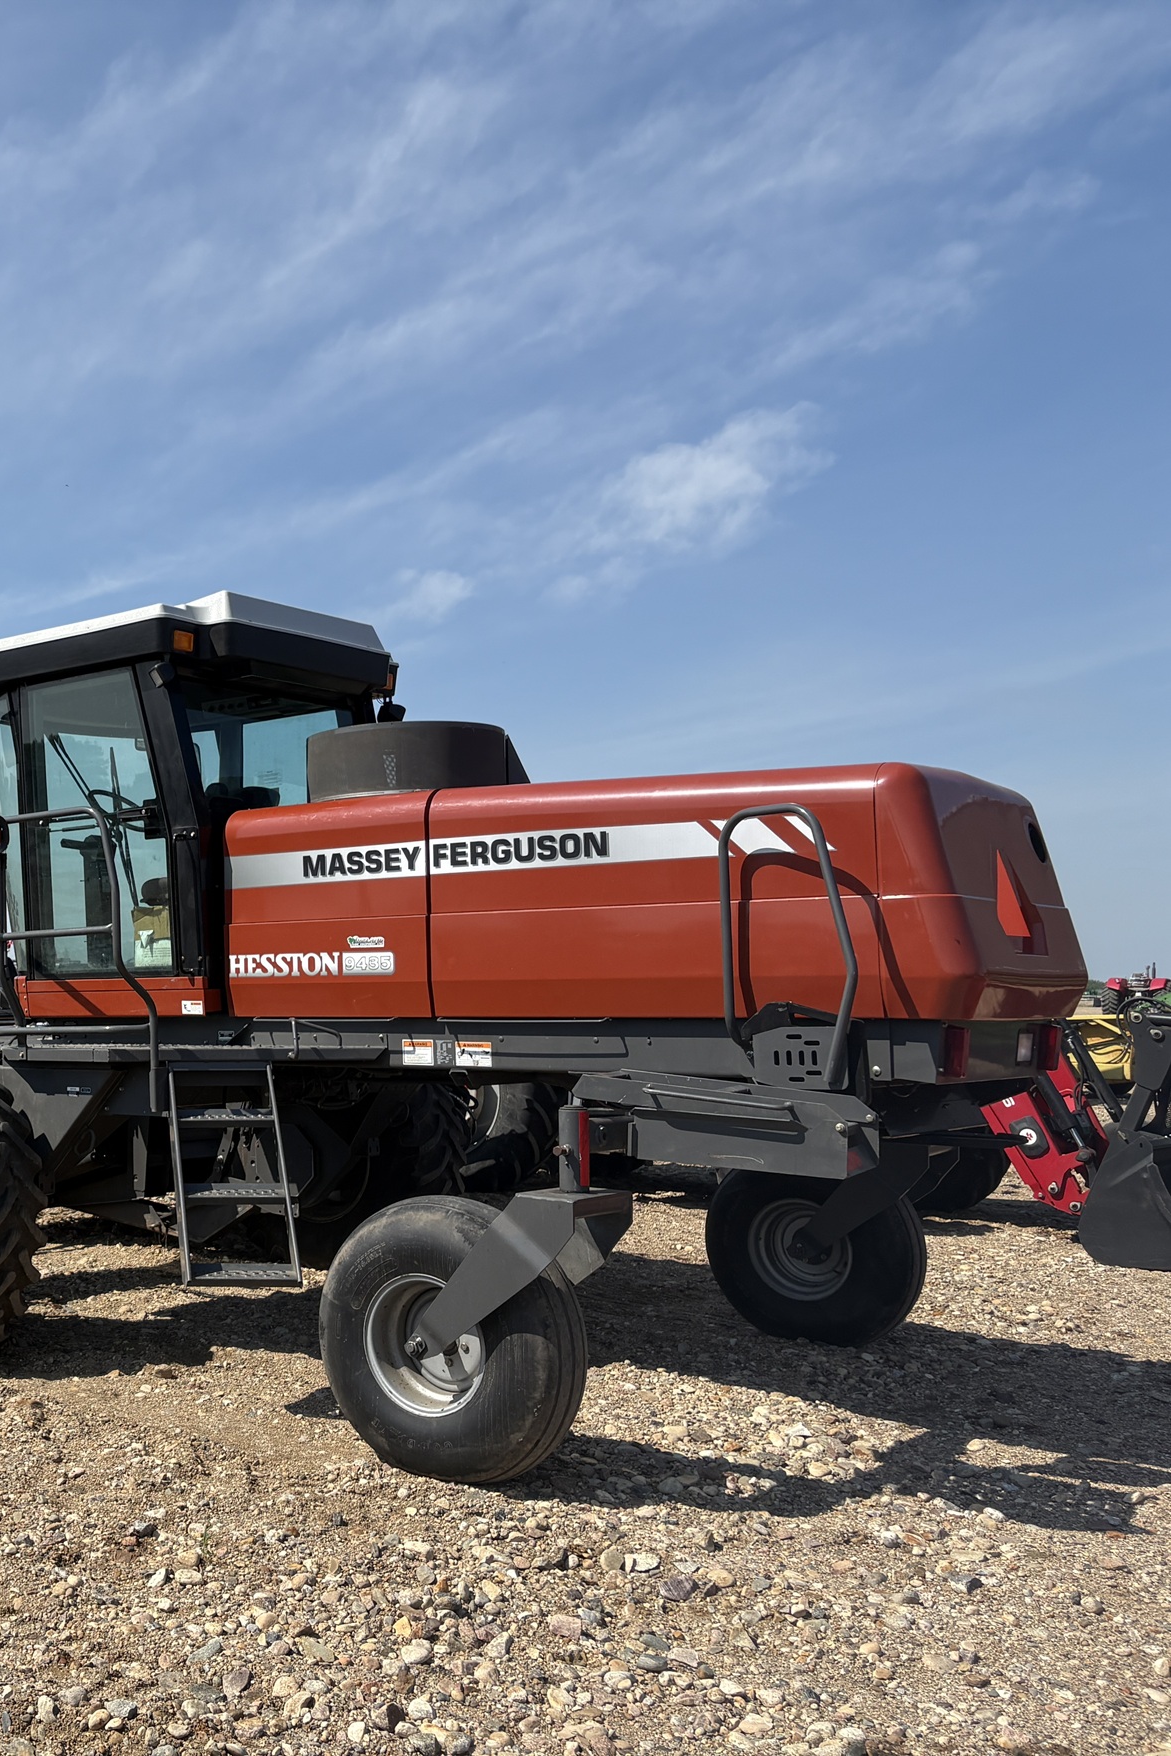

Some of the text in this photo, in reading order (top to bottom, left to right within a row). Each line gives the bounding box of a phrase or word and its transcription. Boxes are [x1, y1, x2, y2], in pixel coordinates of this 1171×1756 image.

[302, 830, 610, 878] MASSEY FERGUSON
[228, 951, 392, 978] HESSTON 9435
